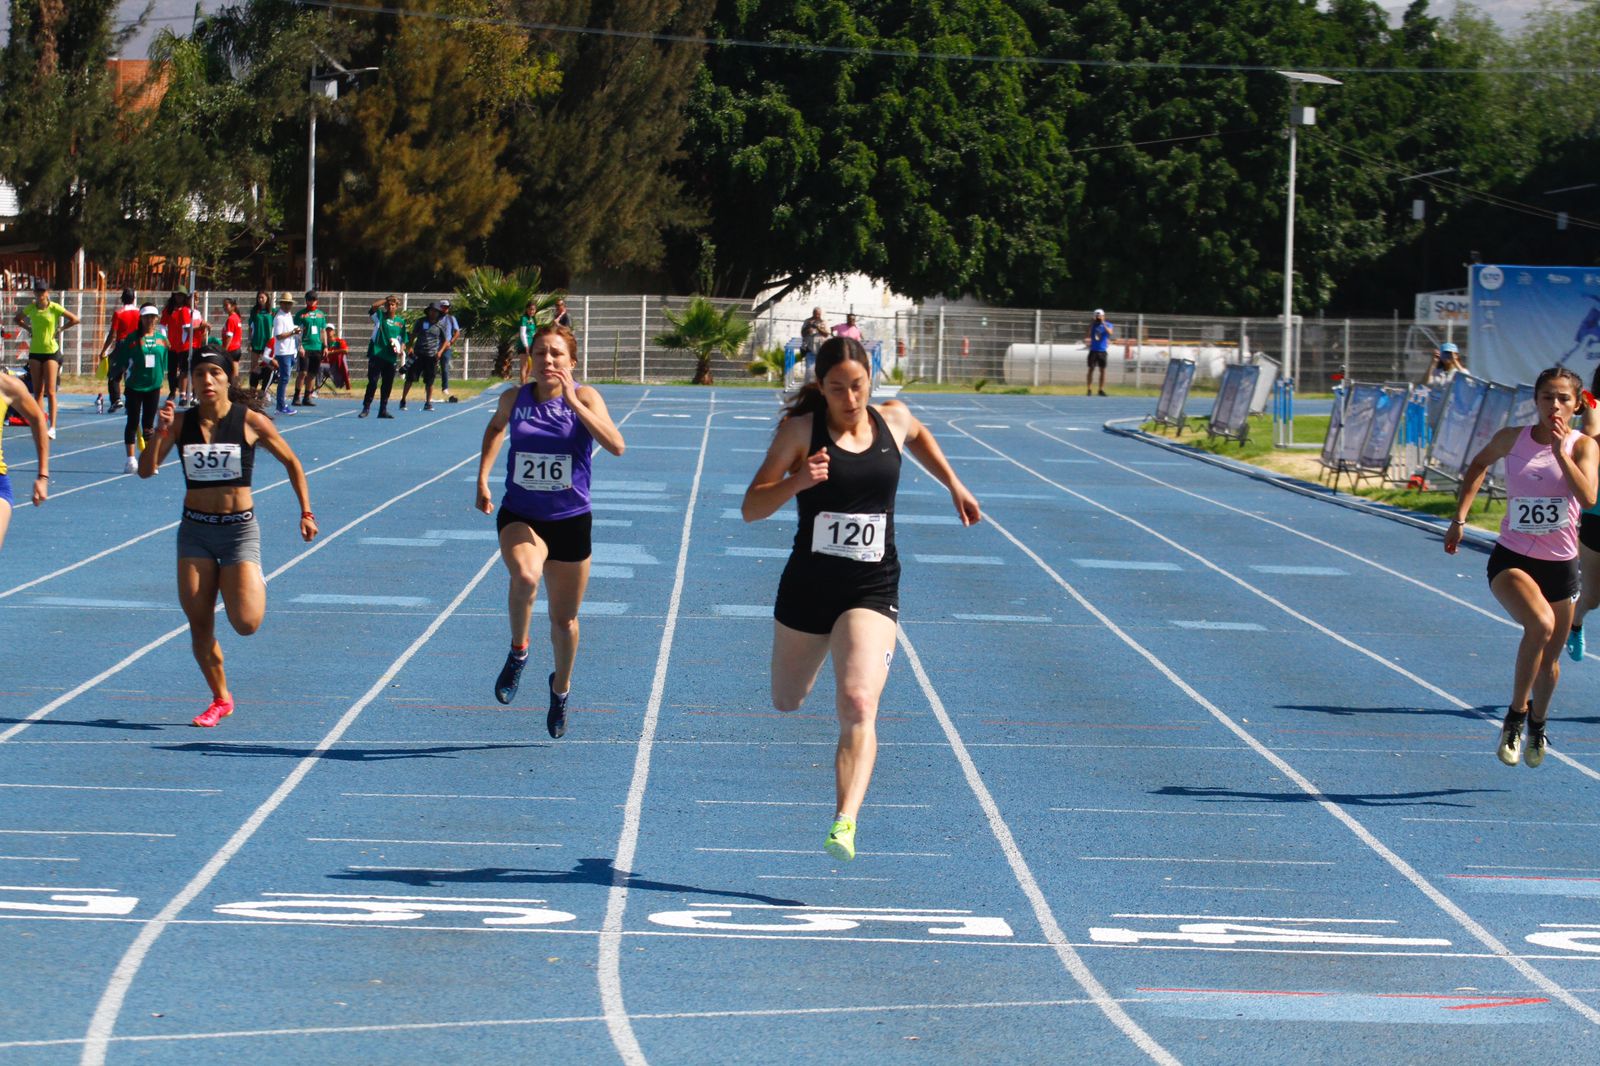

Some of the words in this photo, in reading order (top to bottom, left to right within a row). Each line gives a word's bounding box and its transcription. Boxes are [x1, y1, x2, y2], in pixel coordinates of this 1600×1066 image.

[193, 450, 231, 469] 357
[522, 460, 563, 480] 216
[186, 511, 219, 523] NIKE
[221, 511, 253, 523] PRO
[1518, 504, 1559, 524] 263
[828, 521, 875, 546] 120
[647, 910, 1014, 937] 5
